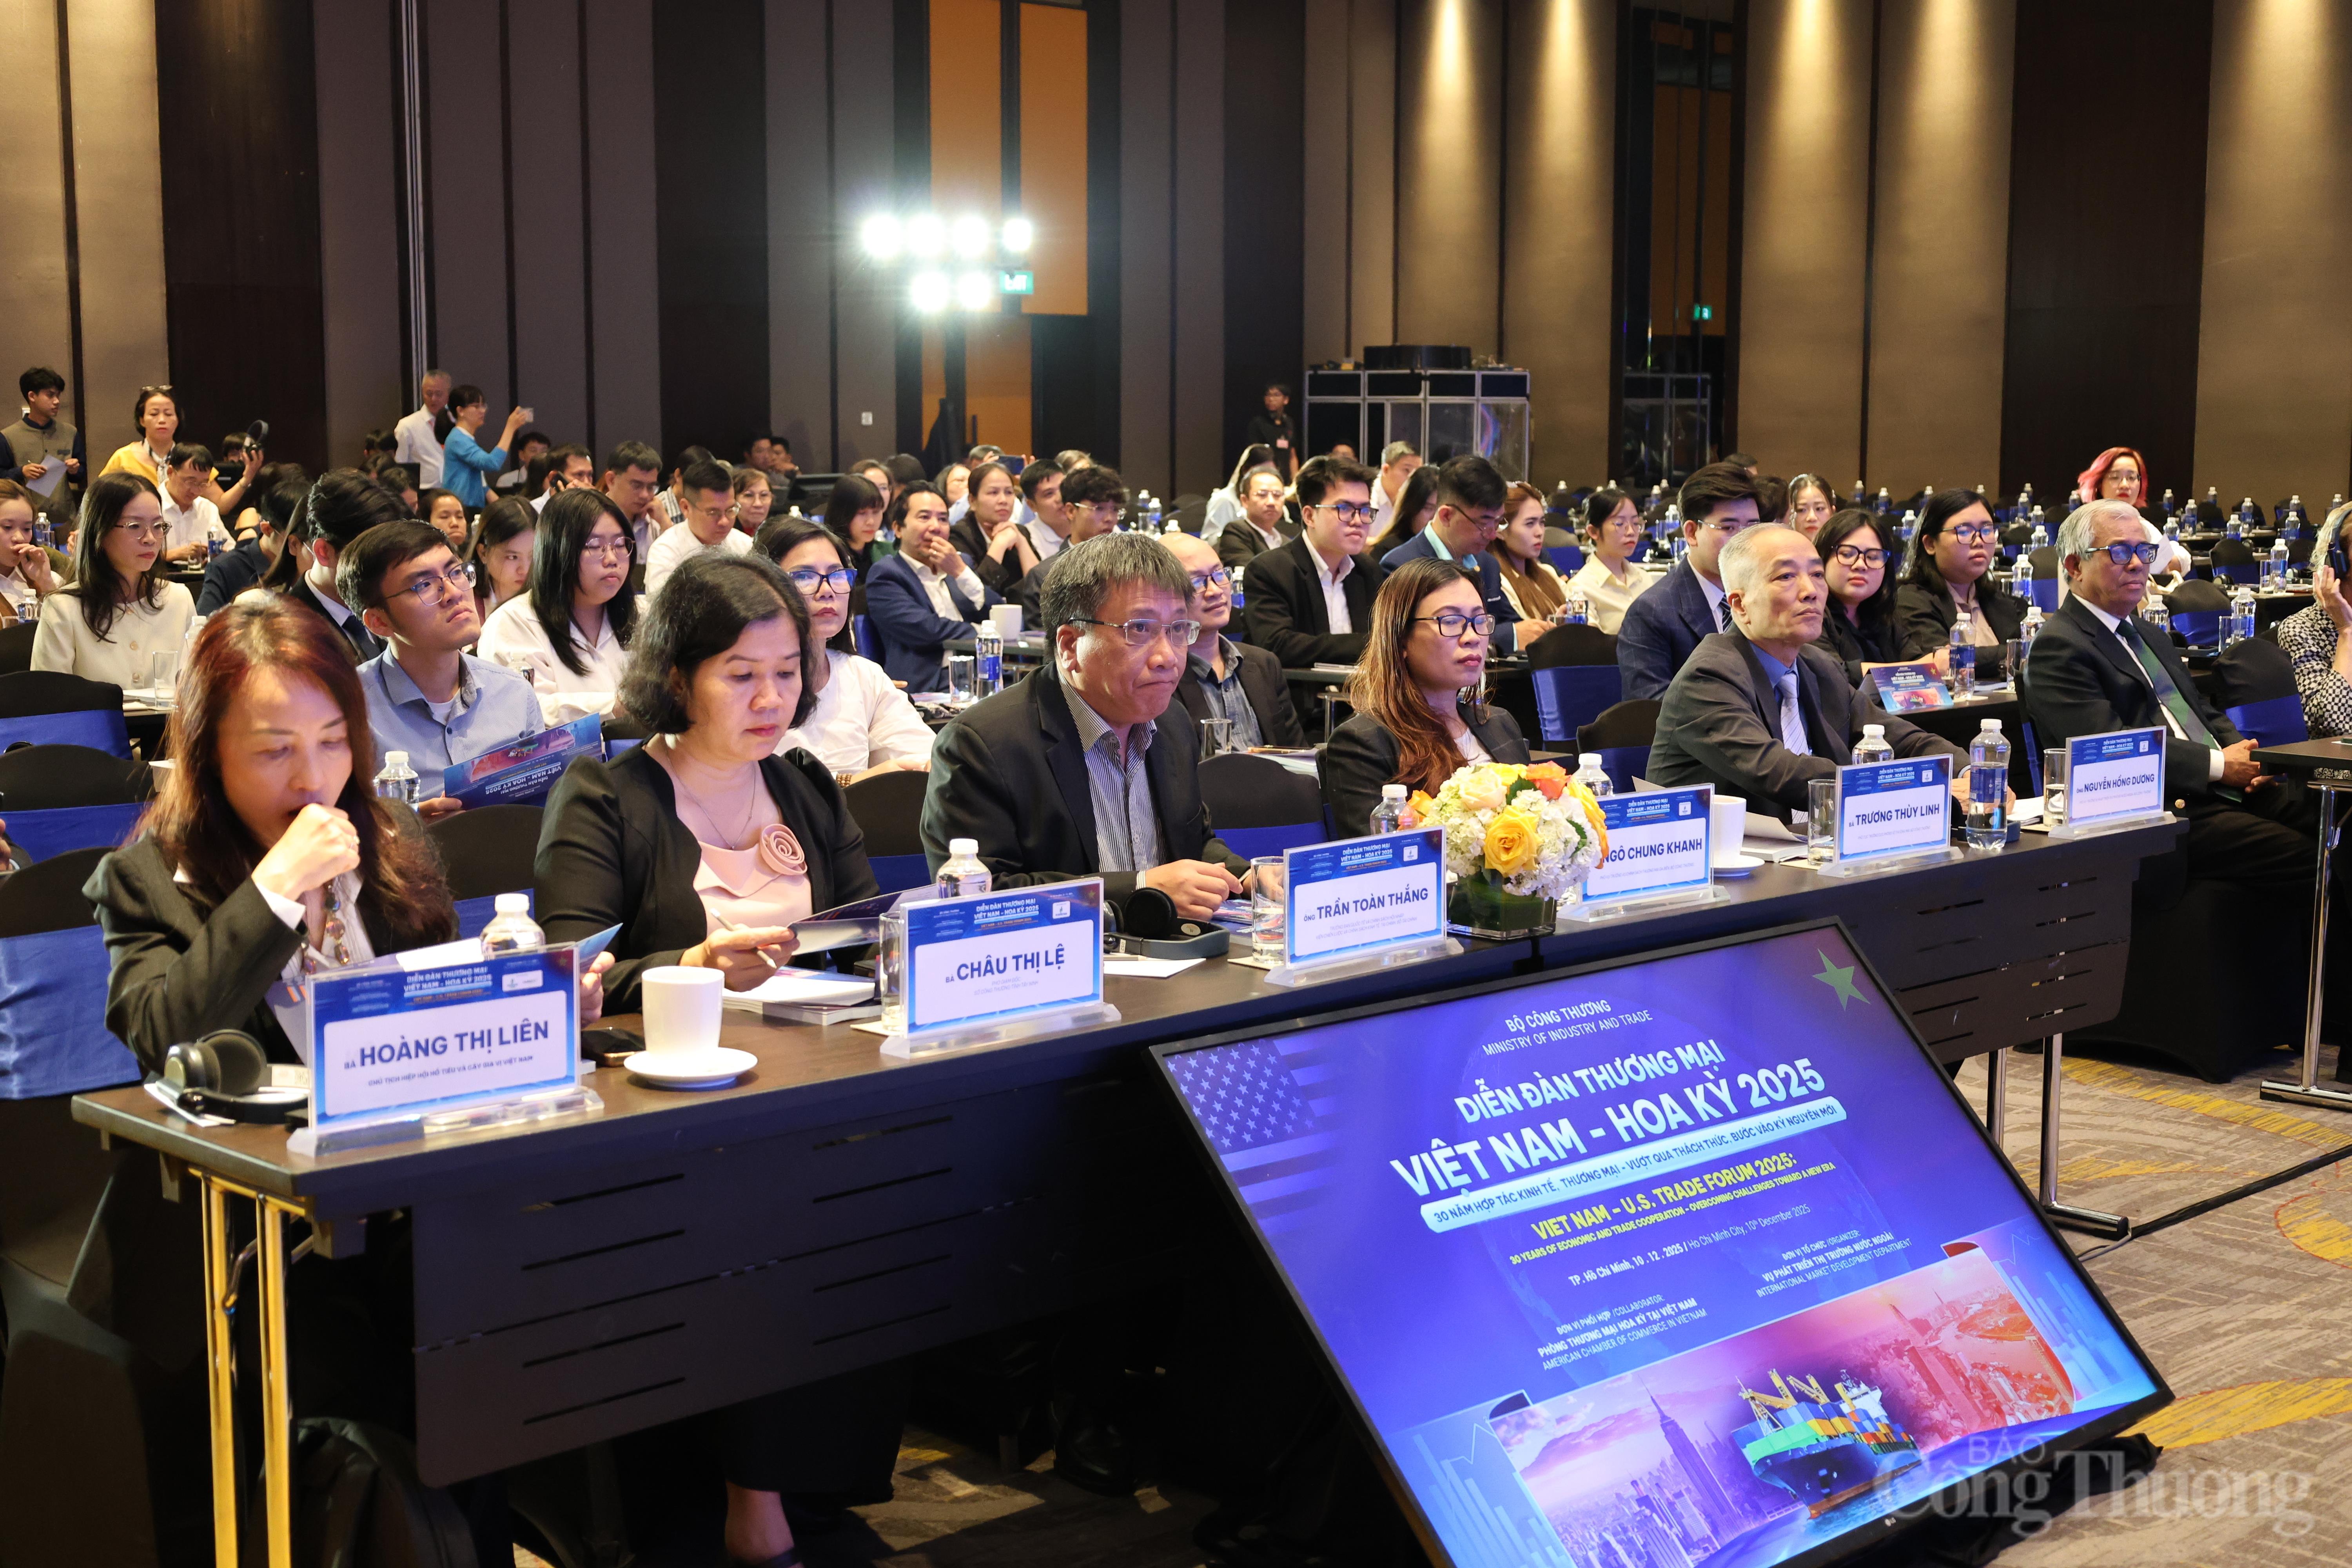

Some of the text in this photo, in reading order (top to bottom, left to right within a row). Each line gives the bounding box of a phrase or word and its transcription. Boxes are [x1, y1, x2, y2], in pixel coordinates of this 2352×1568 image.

[485, 786, 502, 795] 2025
[532, 771, 546, 779] NAM
[2084, 776, 2112, 793] NGUYỄN
[2112, 775, 2131, 788] HỒNG
[2131, 773, 2155, 785] DƯƠNG
[1855, 809, 1893, 826] TRƯƠNG
[1894, 804, 1918, 820] THÙY
[1920, 803, 1940, 817] LINH
[1627, 843, 1664, 860] CHUNG
[1666, 838, 1702, 855] KHANH
[1316, 897, 1350, 919] TRẦN
[1352, 893, 1385, 913] TOÀN
[1387, 883, 1428, 906] THẮNG
[956, 954, 1007, 981] CHÂU
[1012, 951, 1040, 974] THỊ
[1044, 943, 1065, 970] LỆ
[1482, 1009, 1653, 1056] MINISTRY OF INDUSTRY AND TRADE
[1504, 999, 1612, 1033] BỘ CÔNG THƯƠNG
[344, 1018, 548, 1069] BÀ HOÀNG THỊ LIÊN
[1454, 1039, 1726, 1123] DIỄN ĐÀN THƯƠNG MẠI
[1389, 1138, 1490, 1196] VIỆT
[1486, 1118, 1588, 1174] NAM
[1604, 1093, 1695, 1143] HOA
[1683, 1069, 1739, 1122] KỲ
[1737, 1058, 1825, 1109] 2025
[1434, 1211, 1449, 1223] 30
[1448, 1203, 1475, 1219] NĂM
[1495, 1192, 1518, 1205] TÁC
[1517, 1185, 1543, 1200] KINH
[1541, 1180, 1560, 1193] TẾ,
[1559, 1169, 1602, 1188] THƯƠNG
[1600, 1164, 1621, 1178] MẠI
[1625, 1155, 1652, 1170] VƯỢT
[1652, 1150, 1675, 1163] QUA
[1671, 1142, 1705, 1157] THÁCH
[1702, 1135, 1732, 1149] THỨC,
[1730, 1127, 1757, 1142] BƯỚC
[1754, 1122, 1775, 1135] VÀO
[1785, 1109, 1822, 1127] NGUYÊN
[1818, 1104, 1838, 1117] MỚI
[1509, 1161, 1837, 1265] 30 YEARS OF ECONOMIC AND TRADE COOPERATION OVERCOMING CHALLENGES TOWARD A NEW ERA
[1530, 1214, 1572, 1240] VIET
[1569, 1204, 1612, 1230] NAM
[1619, 1193, 1657, 1214] U.S.
[1651, 1176, 1708, 1205] TRADE
[1702, 1162, 1759, 1191] FORUM
[1754, 1152, 1797, 1176] 2025:
[1583, 1269, 1598, 1282] Hồ
[1595, 1265, 1612, 1278] Chí
[1609, 1259, 1635, 1274] Minh,
[1632, 1255, 1645, 1267] 10
[1647, 1250, 1661, 1262] 12
[1662, 1243, 1684, 1258] 2025
[1687, 1239, 1700, 1249] Ho
[1699, 1235, 1713, 1246] Chi
[1711, 1229, 1731, 1242] Minh
[1729, 1226, 1748, 1236] City,
[1758, 1210, 1793, 1227] December
[1791, 1203, 1811, 1217] 2025
[1772, 1265, 1793, 1279] PHÁT
[1811, 1254, 1828, 1265] THỊ
[1852, 1238, 1874, 1252] NƯỚC
[1871, 1231, 1895, 1245] NGOÀI
[1794, 1248, 1804, 1257] VỊ
[1755, 1238, 1912, 1298] INTERNATIONAL MARKET DEVELOPMENT DEPARTMENT
[1537, 1297, 1698, 1357] PHÒNG THƯƠNG MẠI HOA KỲ TẠI VIỆT NAM
[1542, 1308, 1708, 1371] AMERICAN CHAMBER OF COMMERCE IN VIETNAM
[1571, 1320, 1583, 1330] VỊ
